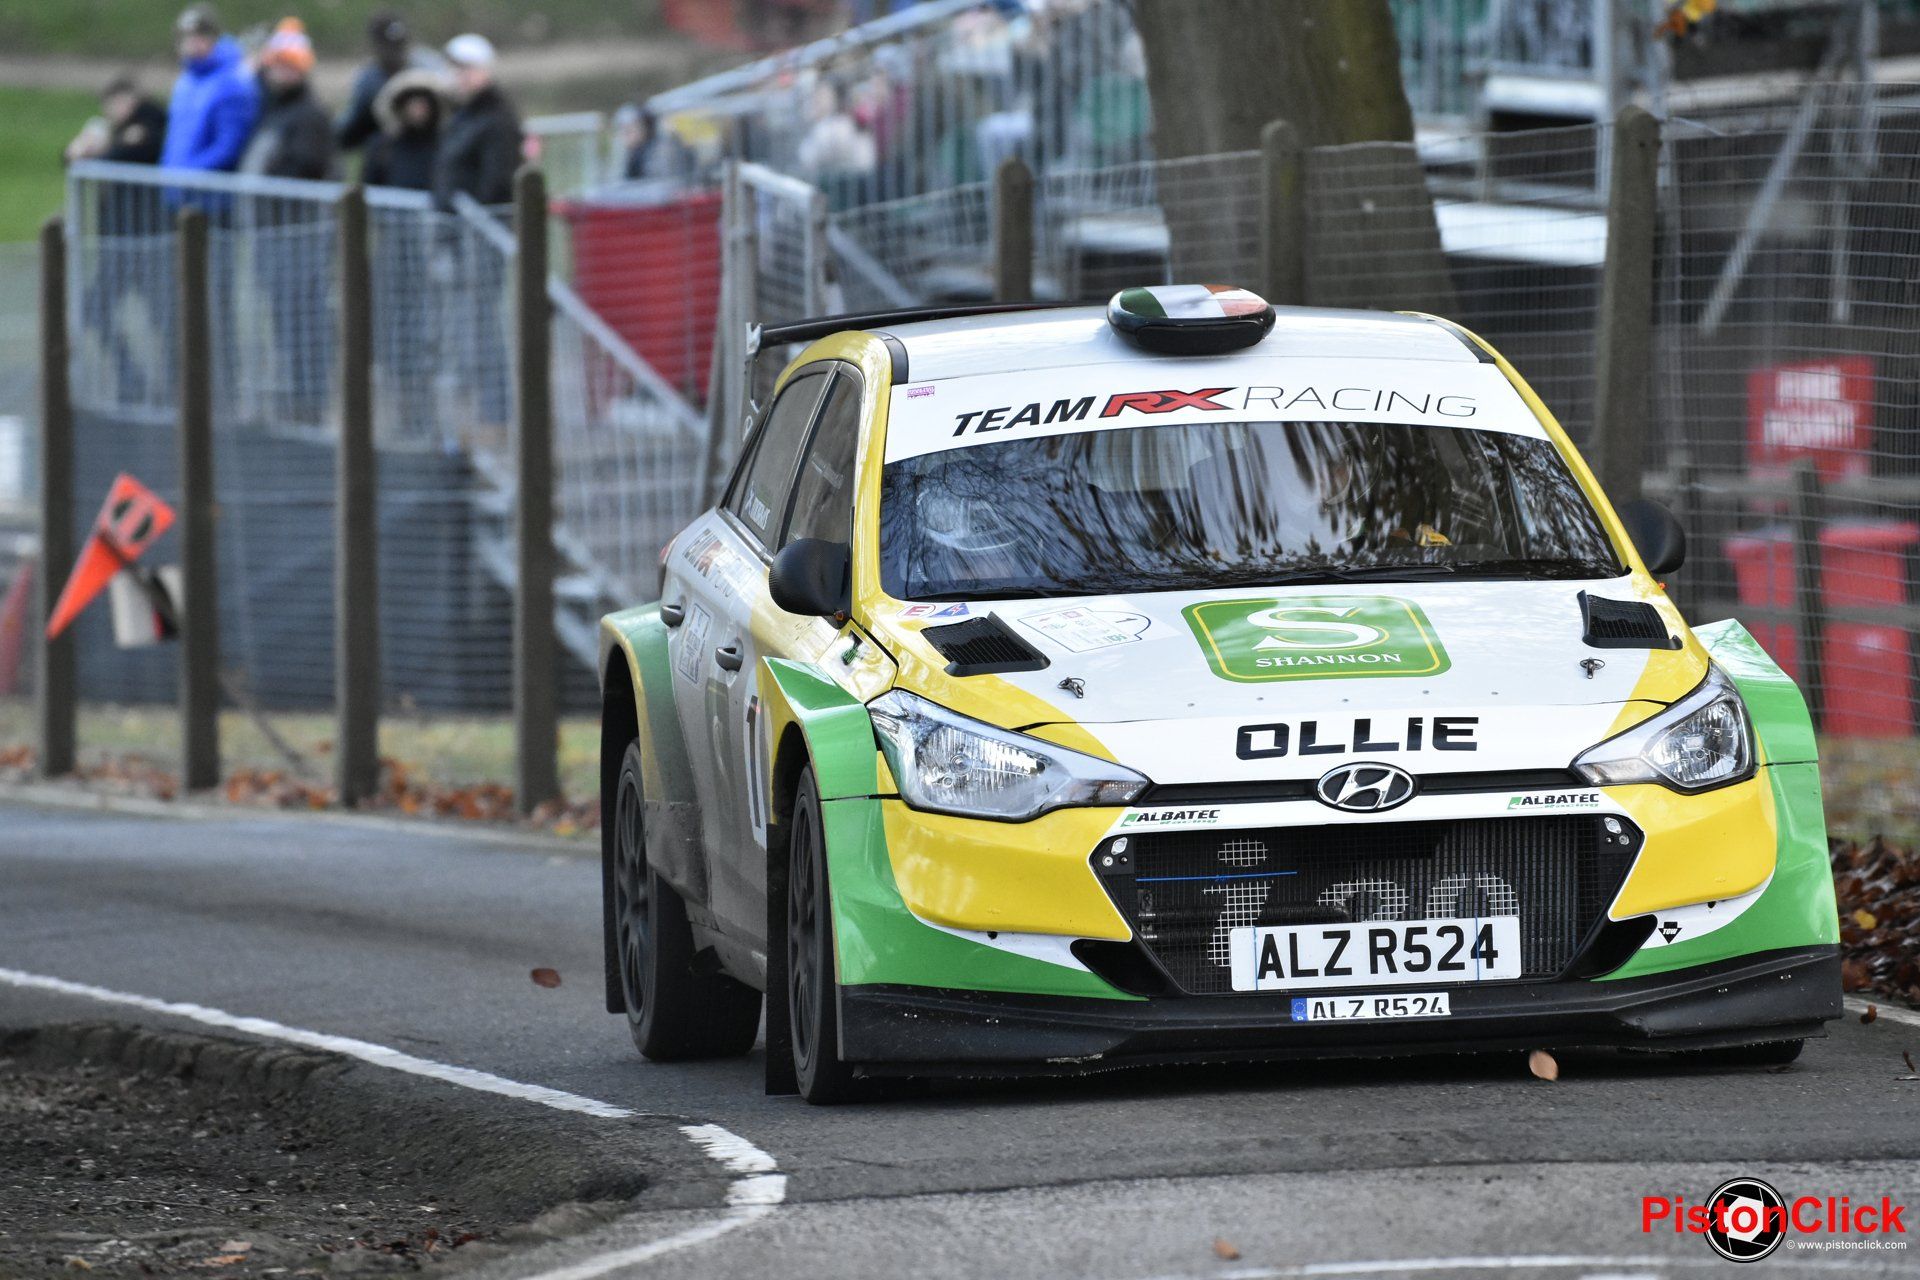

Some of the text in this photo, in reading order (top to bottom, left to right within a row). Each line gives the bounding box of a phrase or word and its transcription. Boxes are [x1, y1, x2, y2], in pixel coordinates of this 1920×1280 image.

[952, 386, 1477, 437] TEAM RX RACING
[1255, 653, 1402, 668] SHANNON
[1236, 716, 1479, 760] OLLIE
[1520, 793, 1600, 806] ALBATEC
[1137, 809, 1221, 822] ALBATEC
[1257, 922, 1499, 980] ALZ R524
[1313, 997, 1445, 1019] ALZ R524
